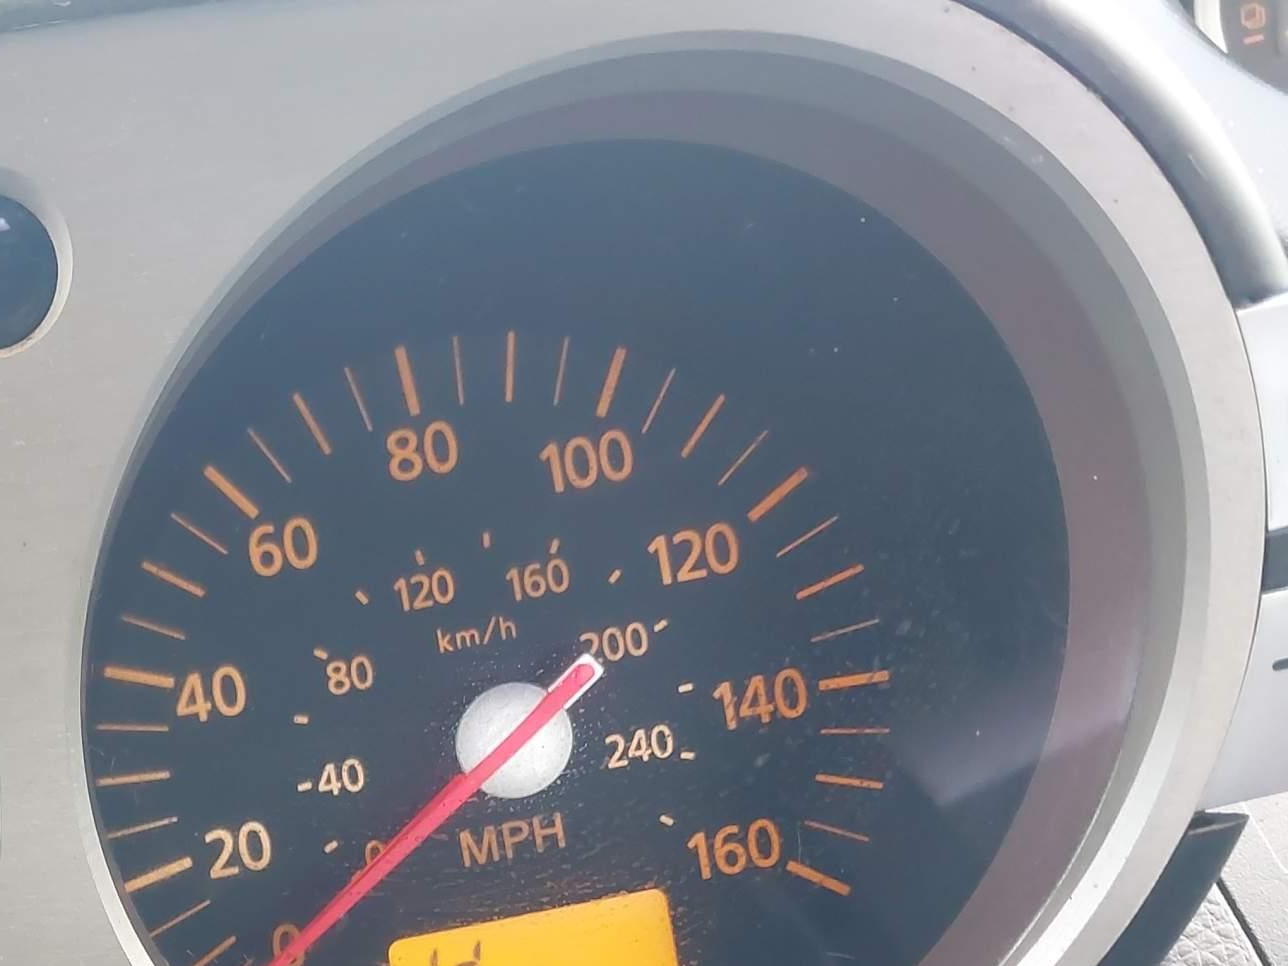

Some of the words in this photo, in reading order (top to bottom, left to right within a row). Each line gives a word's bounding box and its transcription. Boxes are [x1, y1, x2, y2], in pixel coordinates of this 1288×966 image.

[387, 420, 458, 481] 80
[539, 429, 633, 493] 100
[249, 516, 318, 577] 60
[647, 522, 739, 586] 120
[393, 567, 455, 612] 120
[505, 558, 570, 601] 160
[436, 615, 517, 655] km/h
[176, 666, 246, 722] 40
[325, 655, 374, 696] 80
[713, 667, 808, 731] 140
[605, 723, 674, 770] 240
[318, 758, 365, 796] 40
[204, 820, 272, 880] 20
[458, 812, 566, 868] MPH
[687, 817, 782, 881] 160
